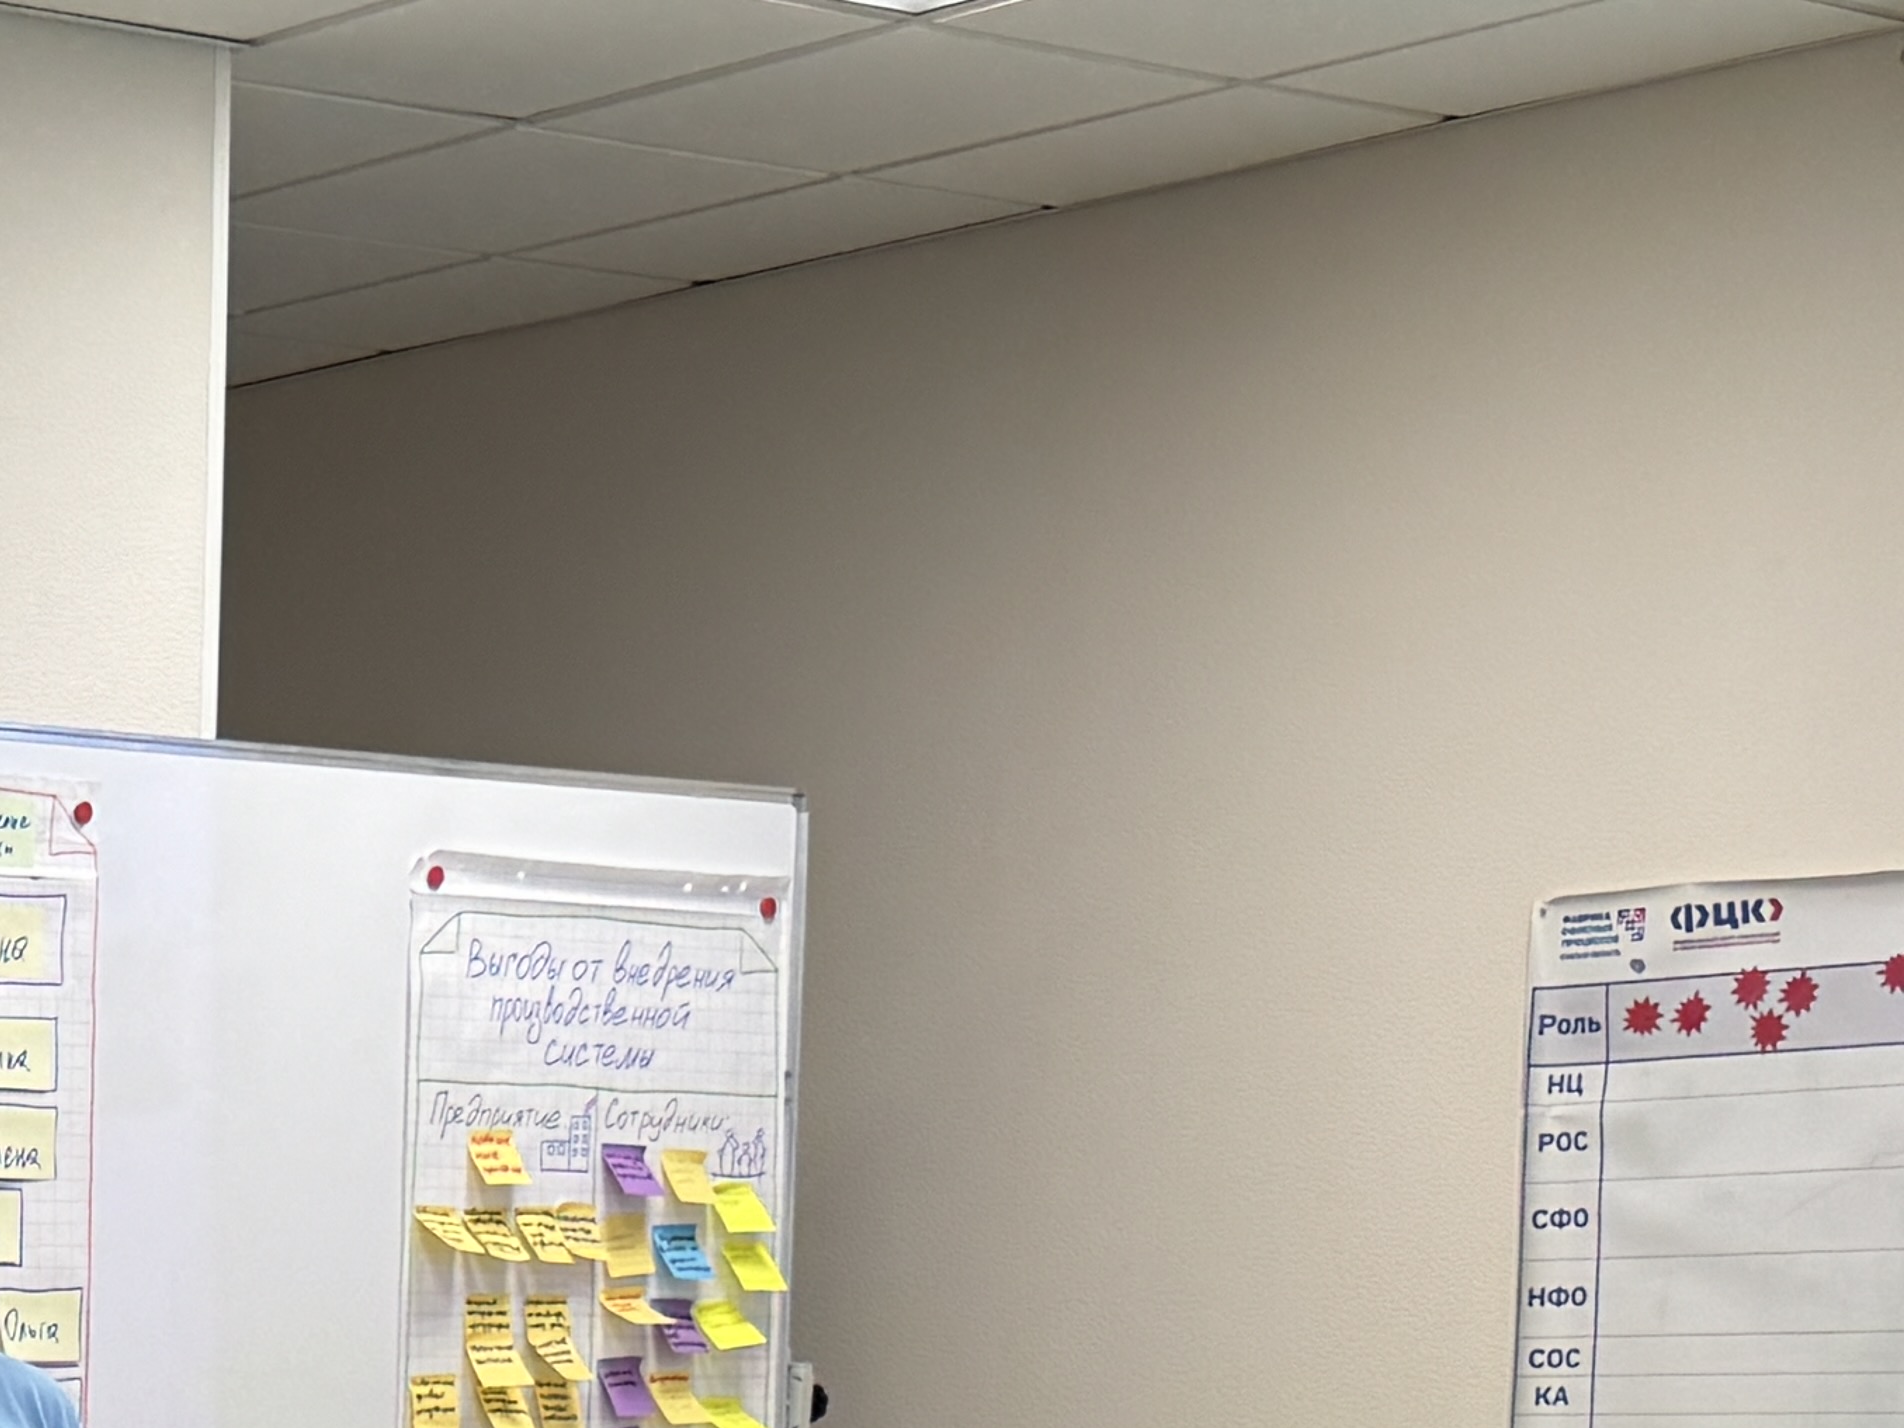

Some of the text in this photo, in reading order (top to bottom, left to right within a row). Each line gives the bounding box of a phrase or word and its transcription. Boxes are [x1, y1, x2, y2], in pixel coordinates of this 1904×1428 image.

[465, 938, 737, 993] Выгоды от внедрения
[490, 986, 691, 1045] производственной
[1536, 1013, 1602, 1037] Роль
[543, 1040, 656, 1071] системы
[1546, 1072, 1584, 1098] НЦ
[1537, 1130, 1590, 1154] РОС
[1531, 1207, 1590, 1231] СФО
[1526, 1285, 1588, 1308] НФО
[4, 1307, 60, 1344] Ольга
[1527, 1347, 1581, 1370] СОС
[1534, 1385, 1570, 1408] КА
